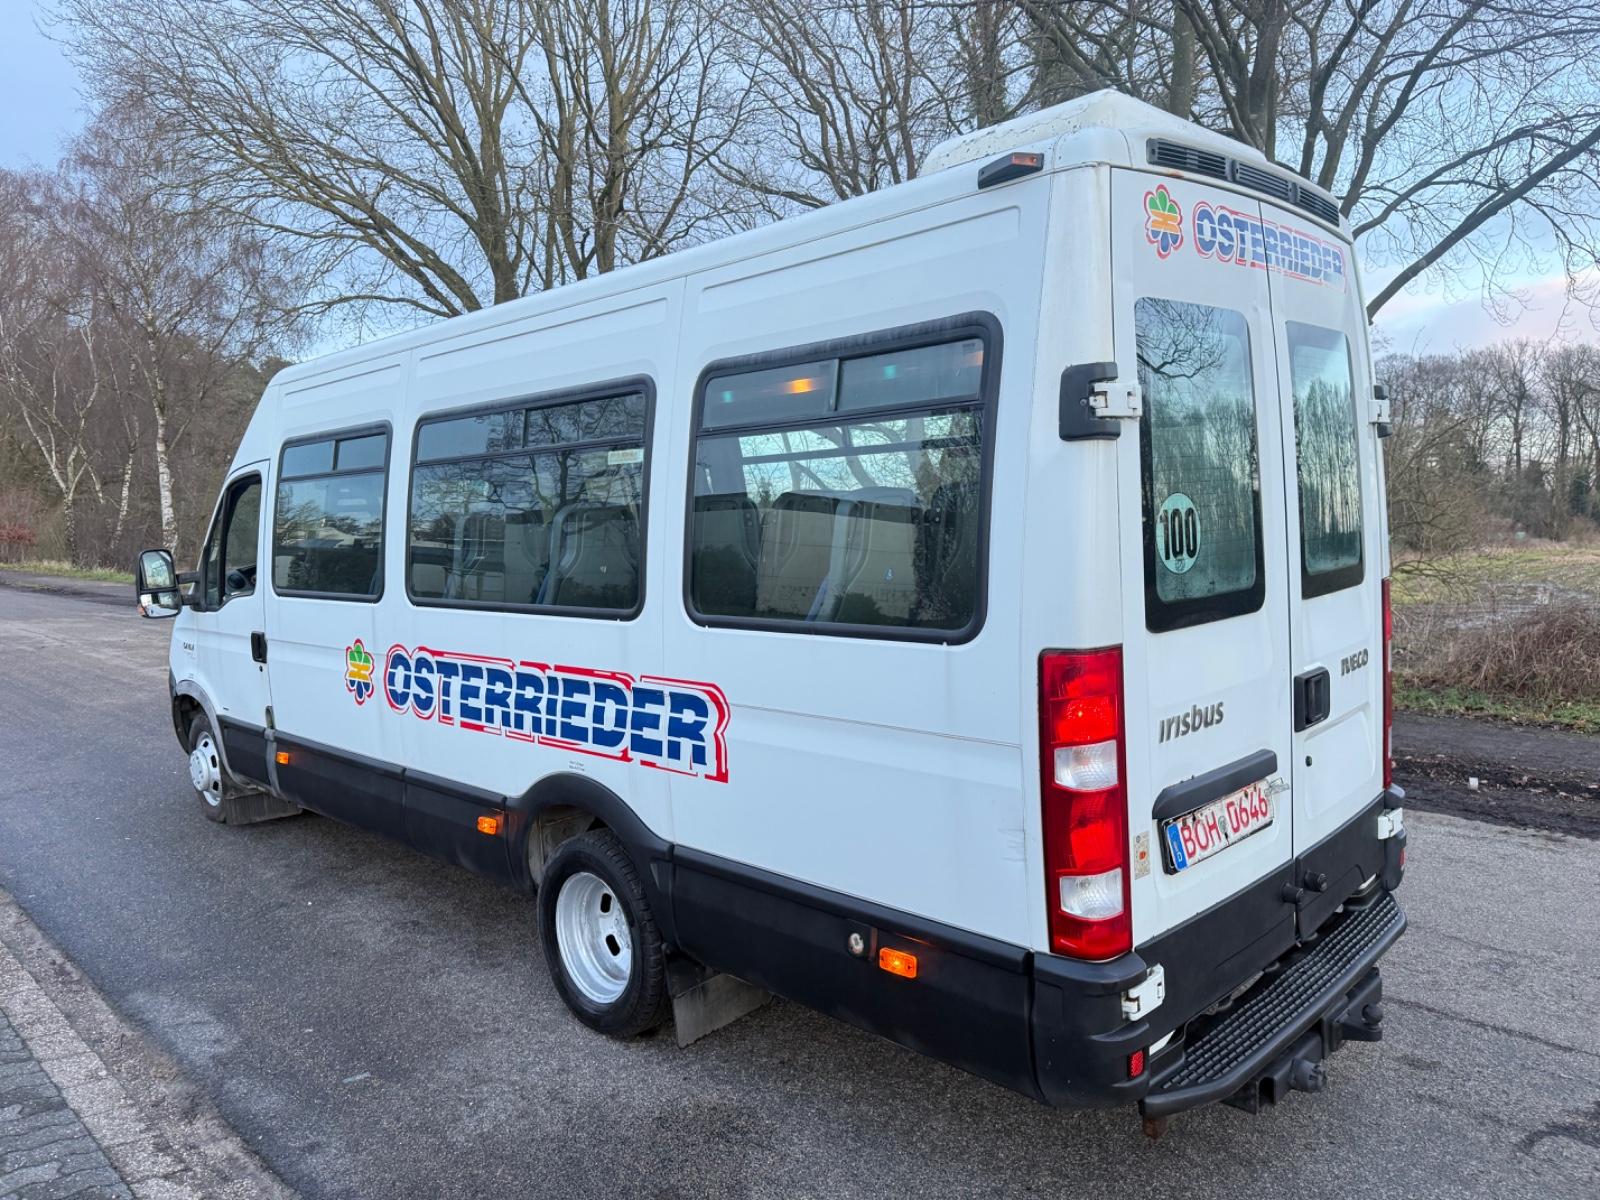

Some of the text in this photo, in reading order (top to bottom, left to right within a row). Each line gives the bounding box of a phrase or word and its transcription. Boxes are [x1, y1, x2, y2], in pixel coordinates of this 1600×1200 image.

[1195, 205, 1344, 286] OSTERRIEDER
[1159, 507, 1198, 561] 100
[1340, 648, 1369, 676] IVECO
[385, 649, 713, 770] OSTERRIEDER
[1181, 811, 1222, 859] BOH
[1226, 787, 1268, 834] 0646
